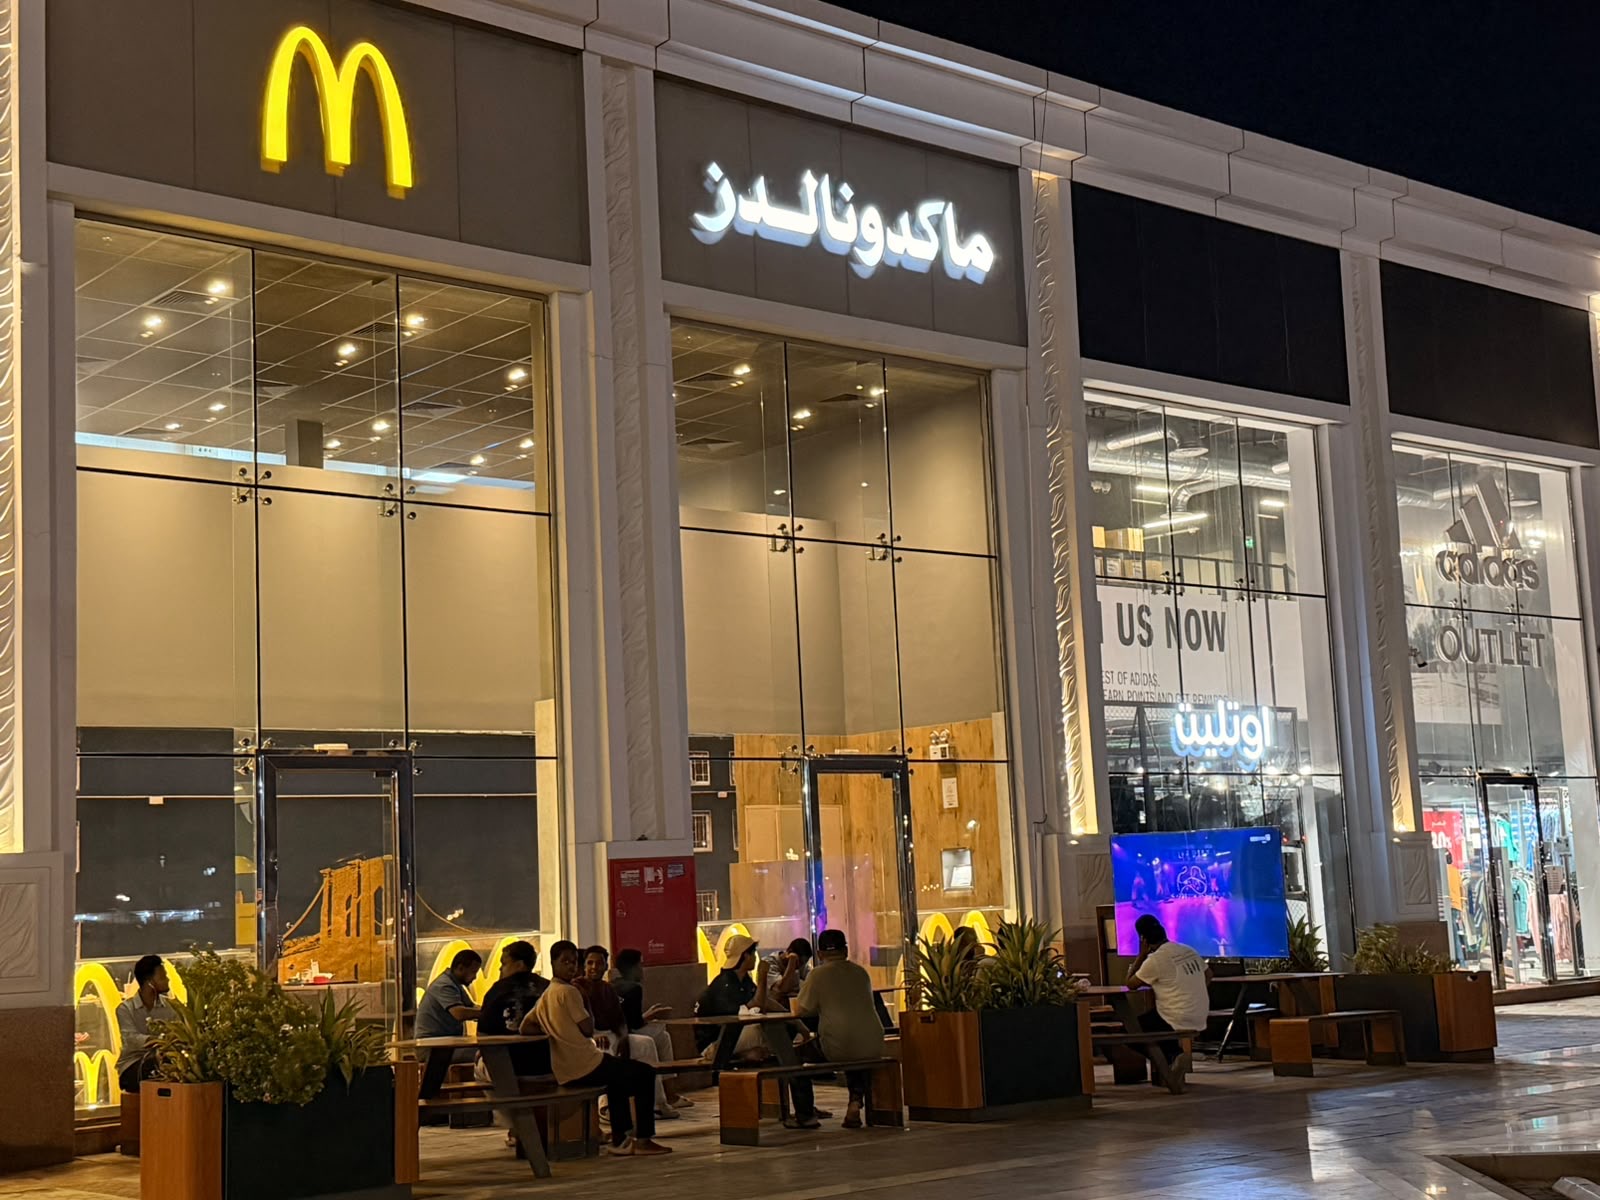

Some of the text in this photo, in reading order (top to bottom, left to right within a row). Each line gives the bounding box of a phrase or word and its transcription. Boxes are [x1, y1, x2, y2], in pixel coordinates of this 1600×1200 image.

[692, 162, 995, 280] ماكدونالدز
[1116, 602, 1154, 648] US
[1164, 606, 1226, 652] NOW
[1436, 625, 1546, 668] OUTLET
[1117, 671, 1128, 685] OF
[1174, 699, 1271, 760] اوتليت
